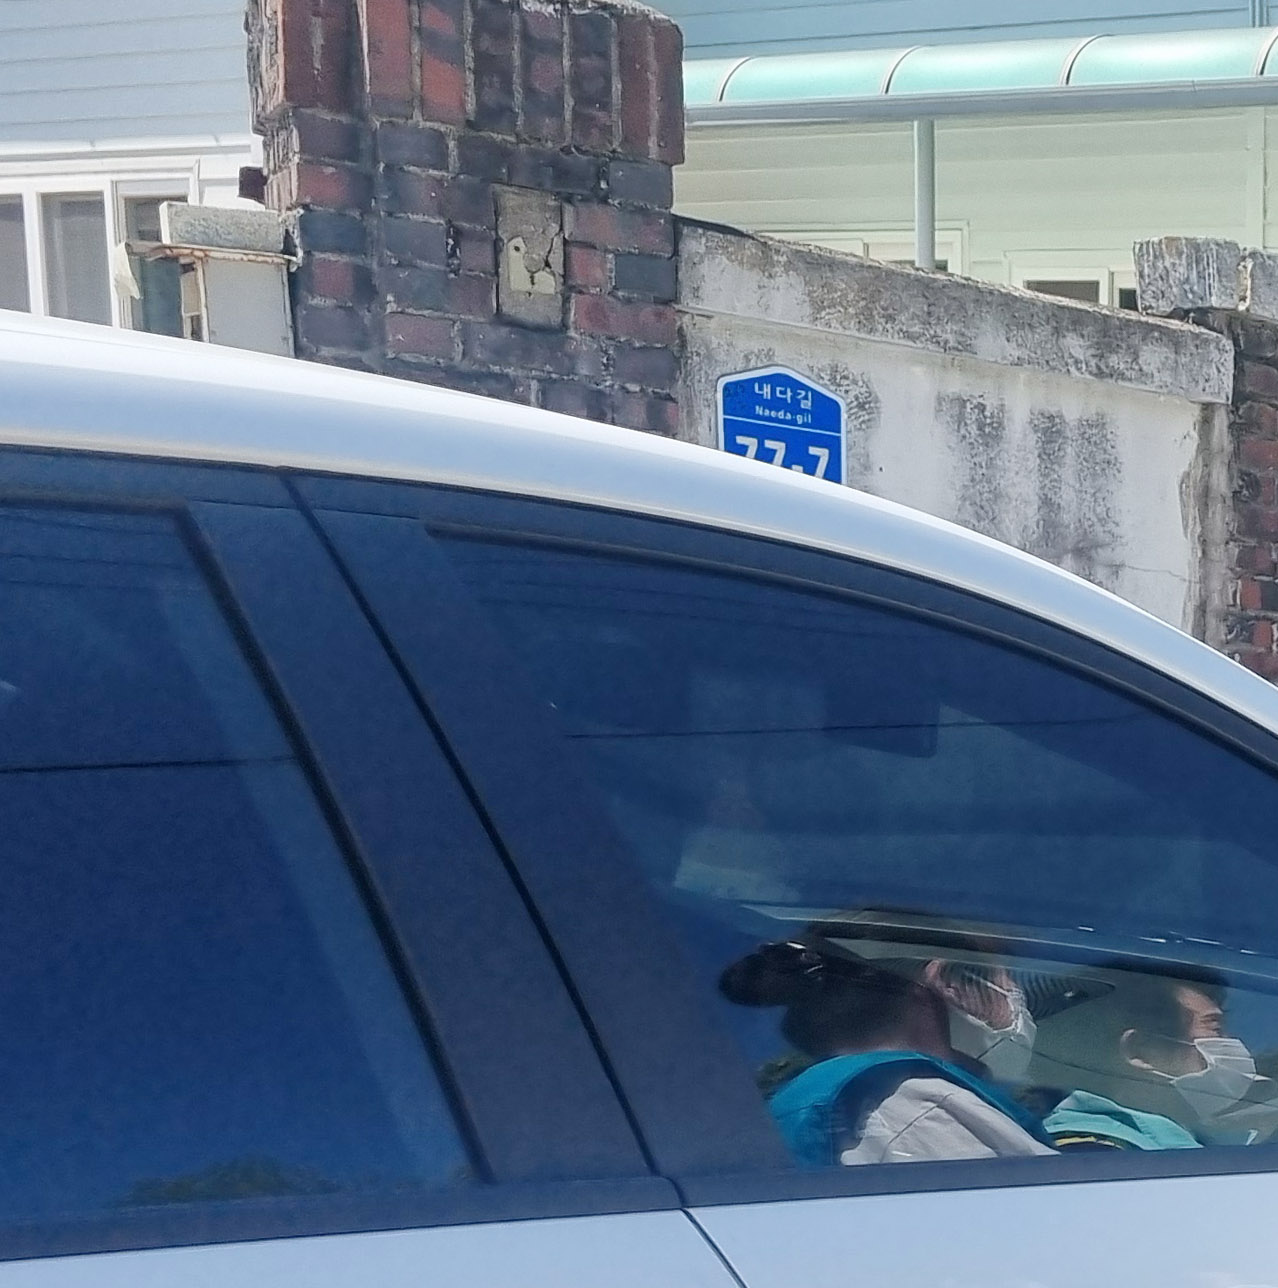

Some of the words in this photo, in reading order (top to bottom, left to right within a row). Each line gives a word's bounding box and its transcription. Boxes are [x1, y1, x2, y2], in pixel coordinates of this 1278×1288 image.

[754, 382, 812, 410] 내다길
[755, 405, 812, 424] Naeda-gil
[735, 435, 830, 479] 77-7
